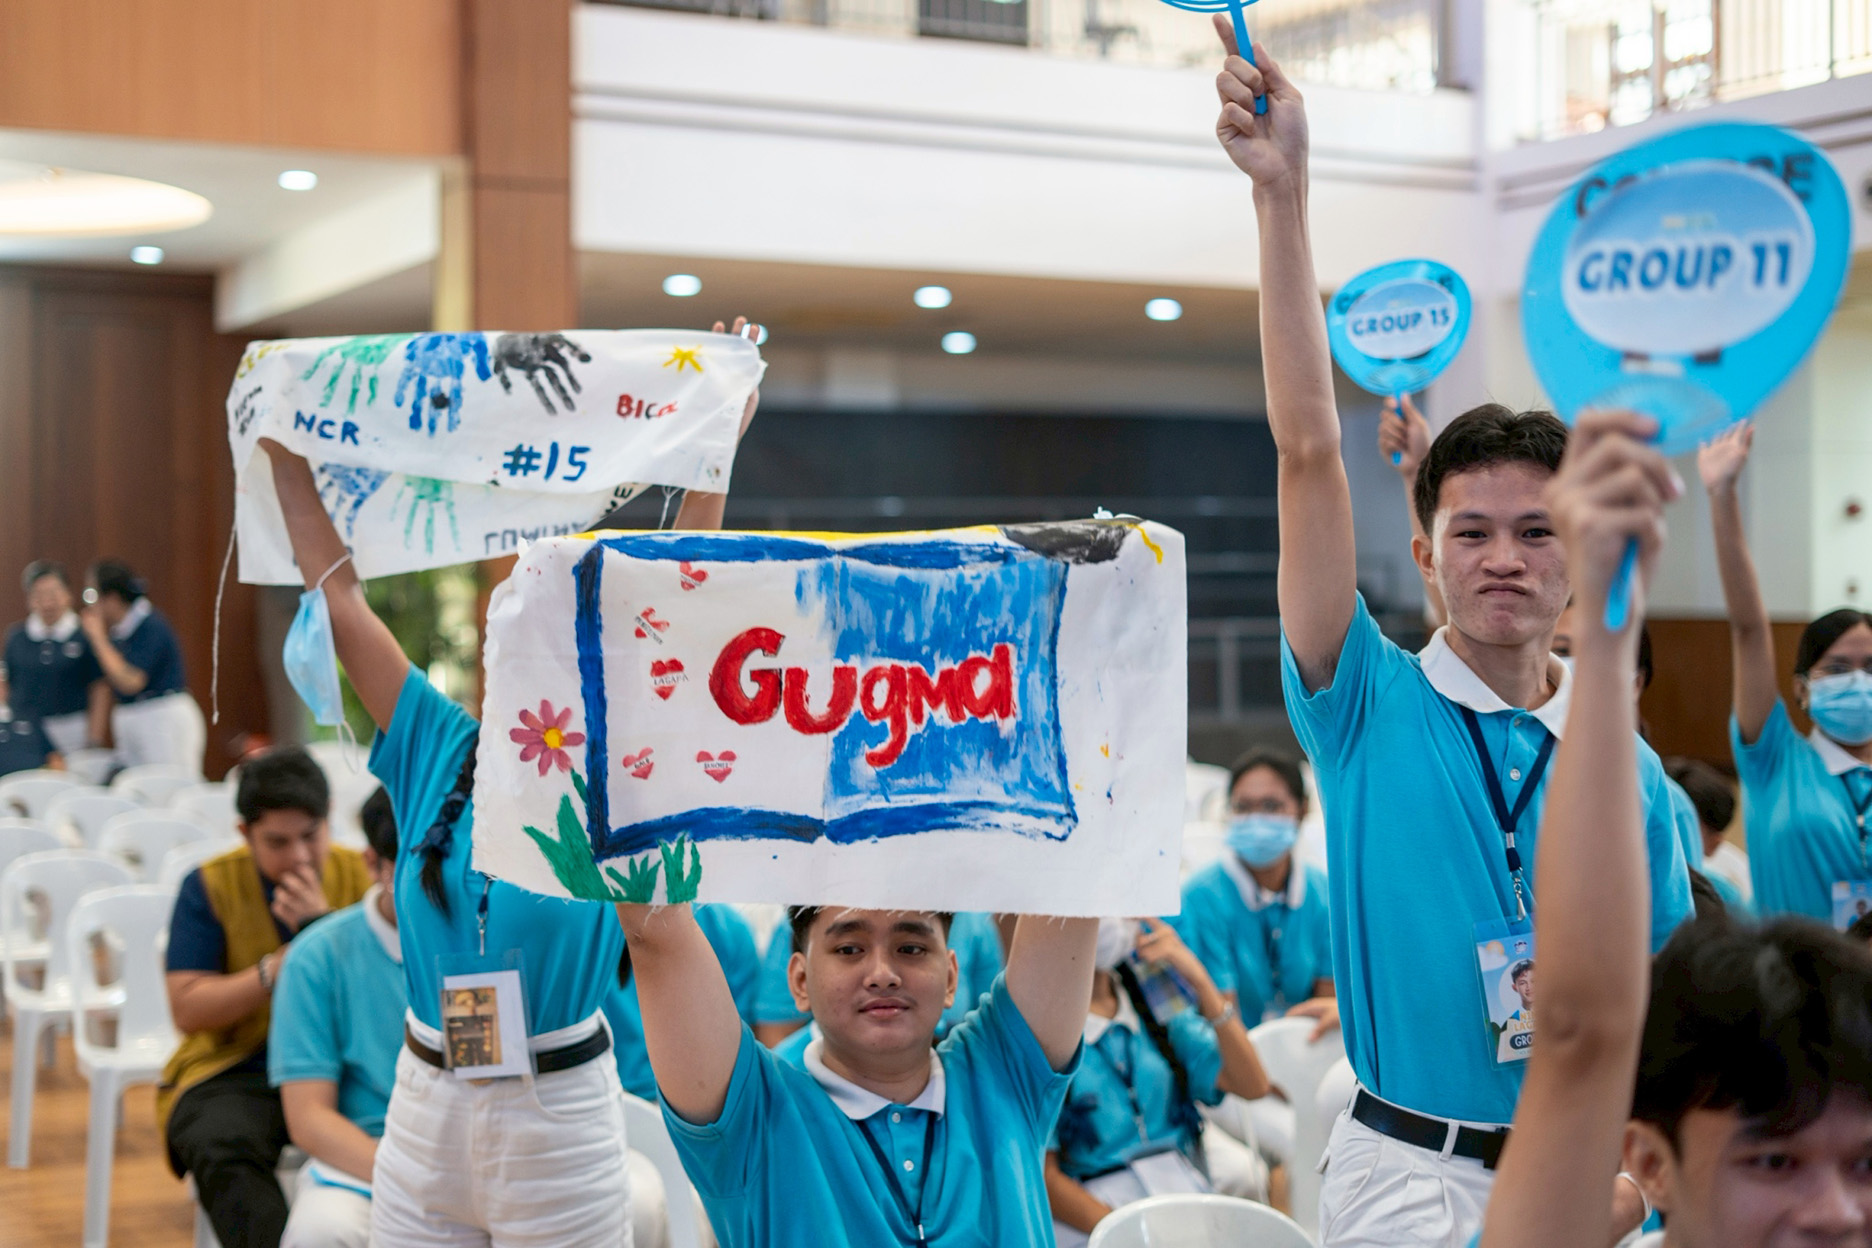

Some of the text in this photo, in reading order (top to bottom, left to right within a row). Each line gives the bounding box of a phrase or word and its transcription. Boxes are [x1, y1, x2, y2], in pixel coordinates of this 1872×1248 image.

[1577, 240, 1792, 293] GROUP 11
[1351, 307, 1451, 337] GROUP 15
[293, 409, 361, 447] NCR
[502, 441, 592, 482] #15
[709, 627, 1017, 767] Gugma
[1514, 1033, 1534, 1048] GRO
